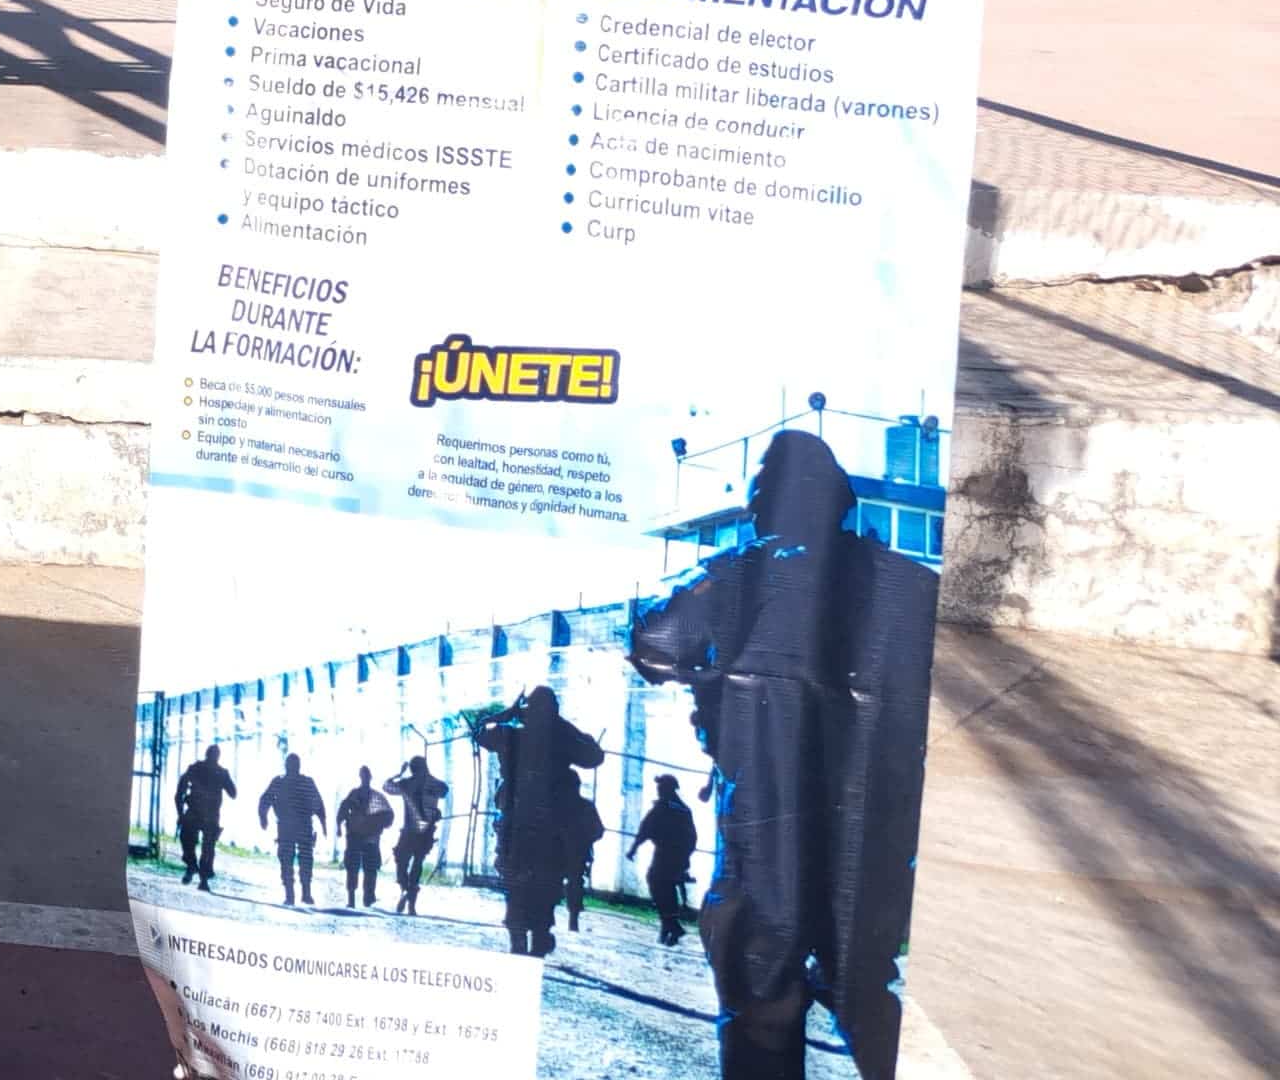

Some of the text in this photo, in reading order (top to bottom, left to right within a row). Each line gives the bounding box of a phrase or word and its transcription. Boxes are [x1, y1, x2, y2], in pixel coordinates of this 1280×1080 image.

[253, 17, 365, 43] Vacaciones
[599, 14, 817, 52] Credencial de elector
[250, 45, 422, 76] Prima vacacional
[597, 43, 834, 84] Certificado de estudios
[248, 74, 526, 113] Sueldo de $15,426 mensual
[594, 72, 941, 126] Cartilla militar liberada (varones)
[245, 103, 347, 128] Aguinaldo
[593, 103, 805, 141] Licencia de conducir
[245, 130, 513, 169] Servicios médicos ISSSTE
[645, 136, 787, 169] de nacimiento
[244, 157, 472, 196] Dotación de uniformes
[588, 160, 863, 207] Comprobante de domicilio
[257, 190, 400, 219] equipo táctico
[587, 189, 755, 226] Curriculum vitae
[241, 214, 368, 246] Alimentación
[586, 219, 637, 246] Curp
[218, 264, 349, 304] BENEFICIOS
[231, 298, 333, 338] DURANTE
[190, 329, 362, 375] LA FORMACIÓN:
[417, 340, 615, 402] ¡ÚNETE!
[167, 934, 368, 981] INTERESADOS COMUNICARSE
[244, 1001, 283, 1023] (667)
[210, 1023, 259, 1047] Mochis
